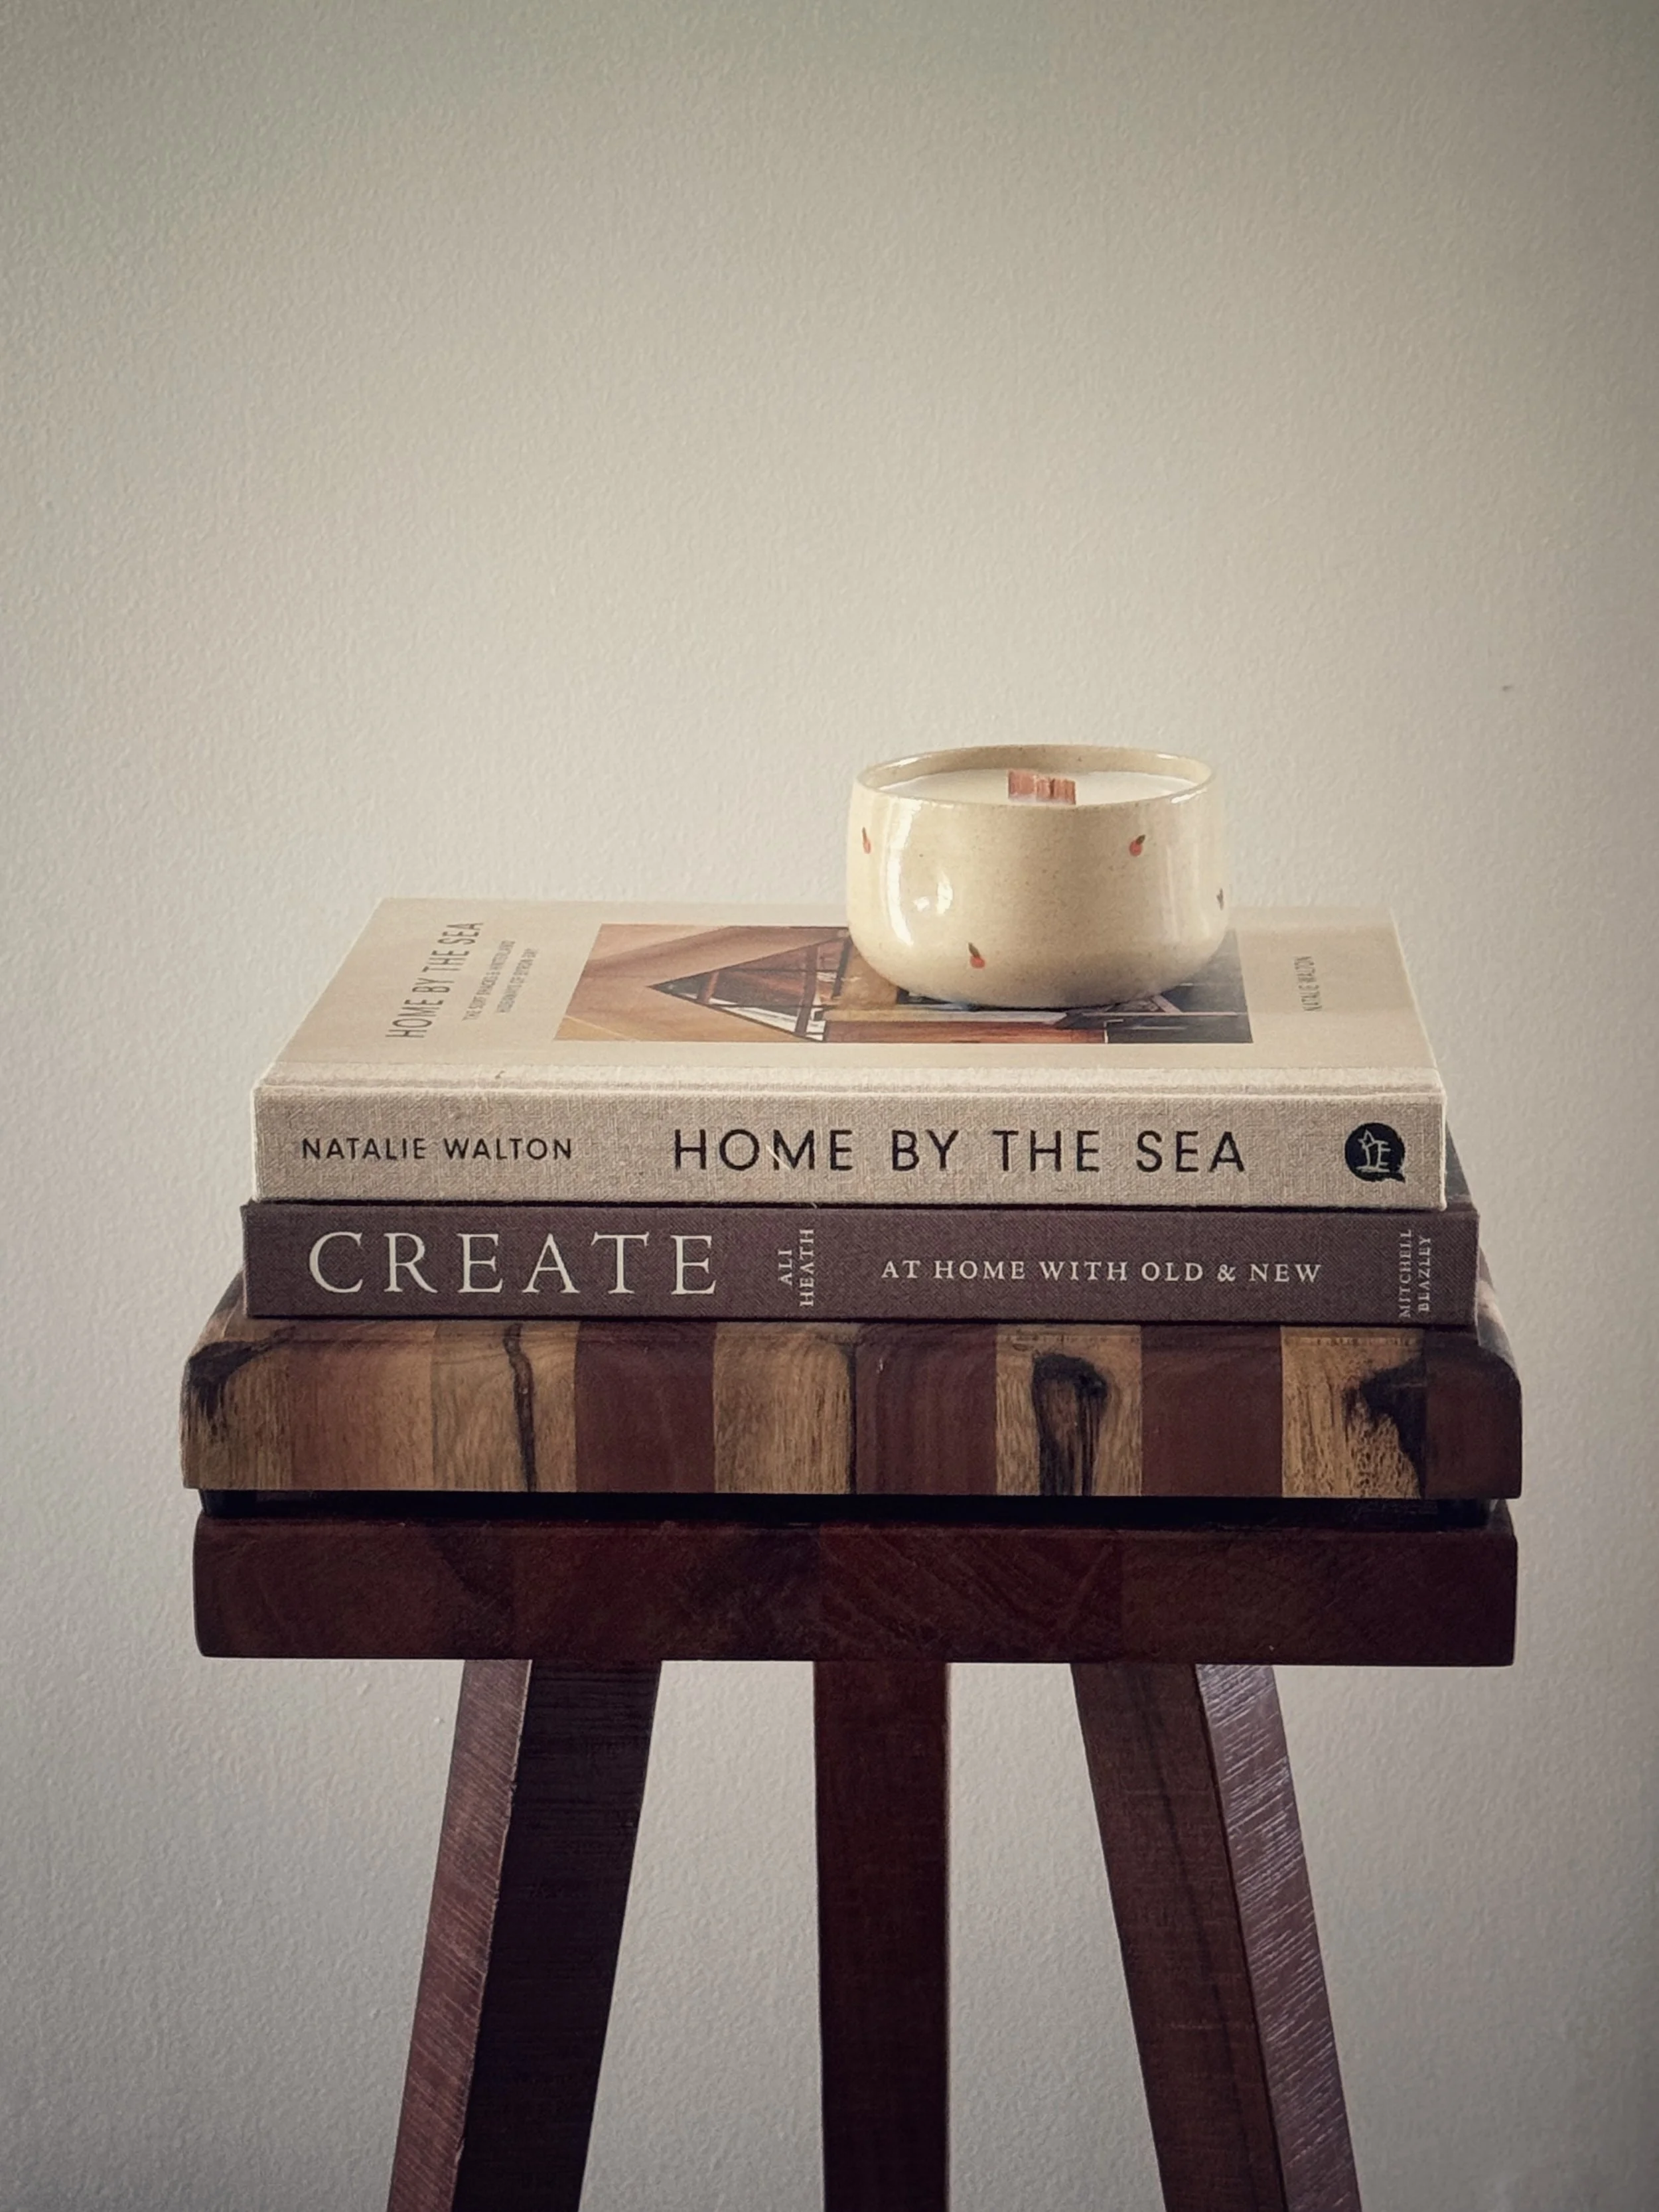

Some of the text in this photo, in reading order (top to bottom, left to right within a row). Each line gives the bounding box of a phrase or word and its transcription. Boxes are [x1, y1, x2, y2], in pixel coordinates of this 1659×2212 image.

[385, 922, 484, 1038] HOME BY THE SEA
[301, 1137, 572, 1161] NATALIE WALTON
[674, 1128, 1246, 1173] HOME BY THE SEA
[309, 1231, 717, 1295] CREATE
[777, 1249, 794, 1286] ALI
[799, 1228, 815, 1307] HEATH
[881, 1260, 1322, 1283] AT HOME WITH OLD & NEW
[1398, 1228, 1413, 1318] MITCHELL
[1417, 1236, 1432, 1313] BLAZLEY
